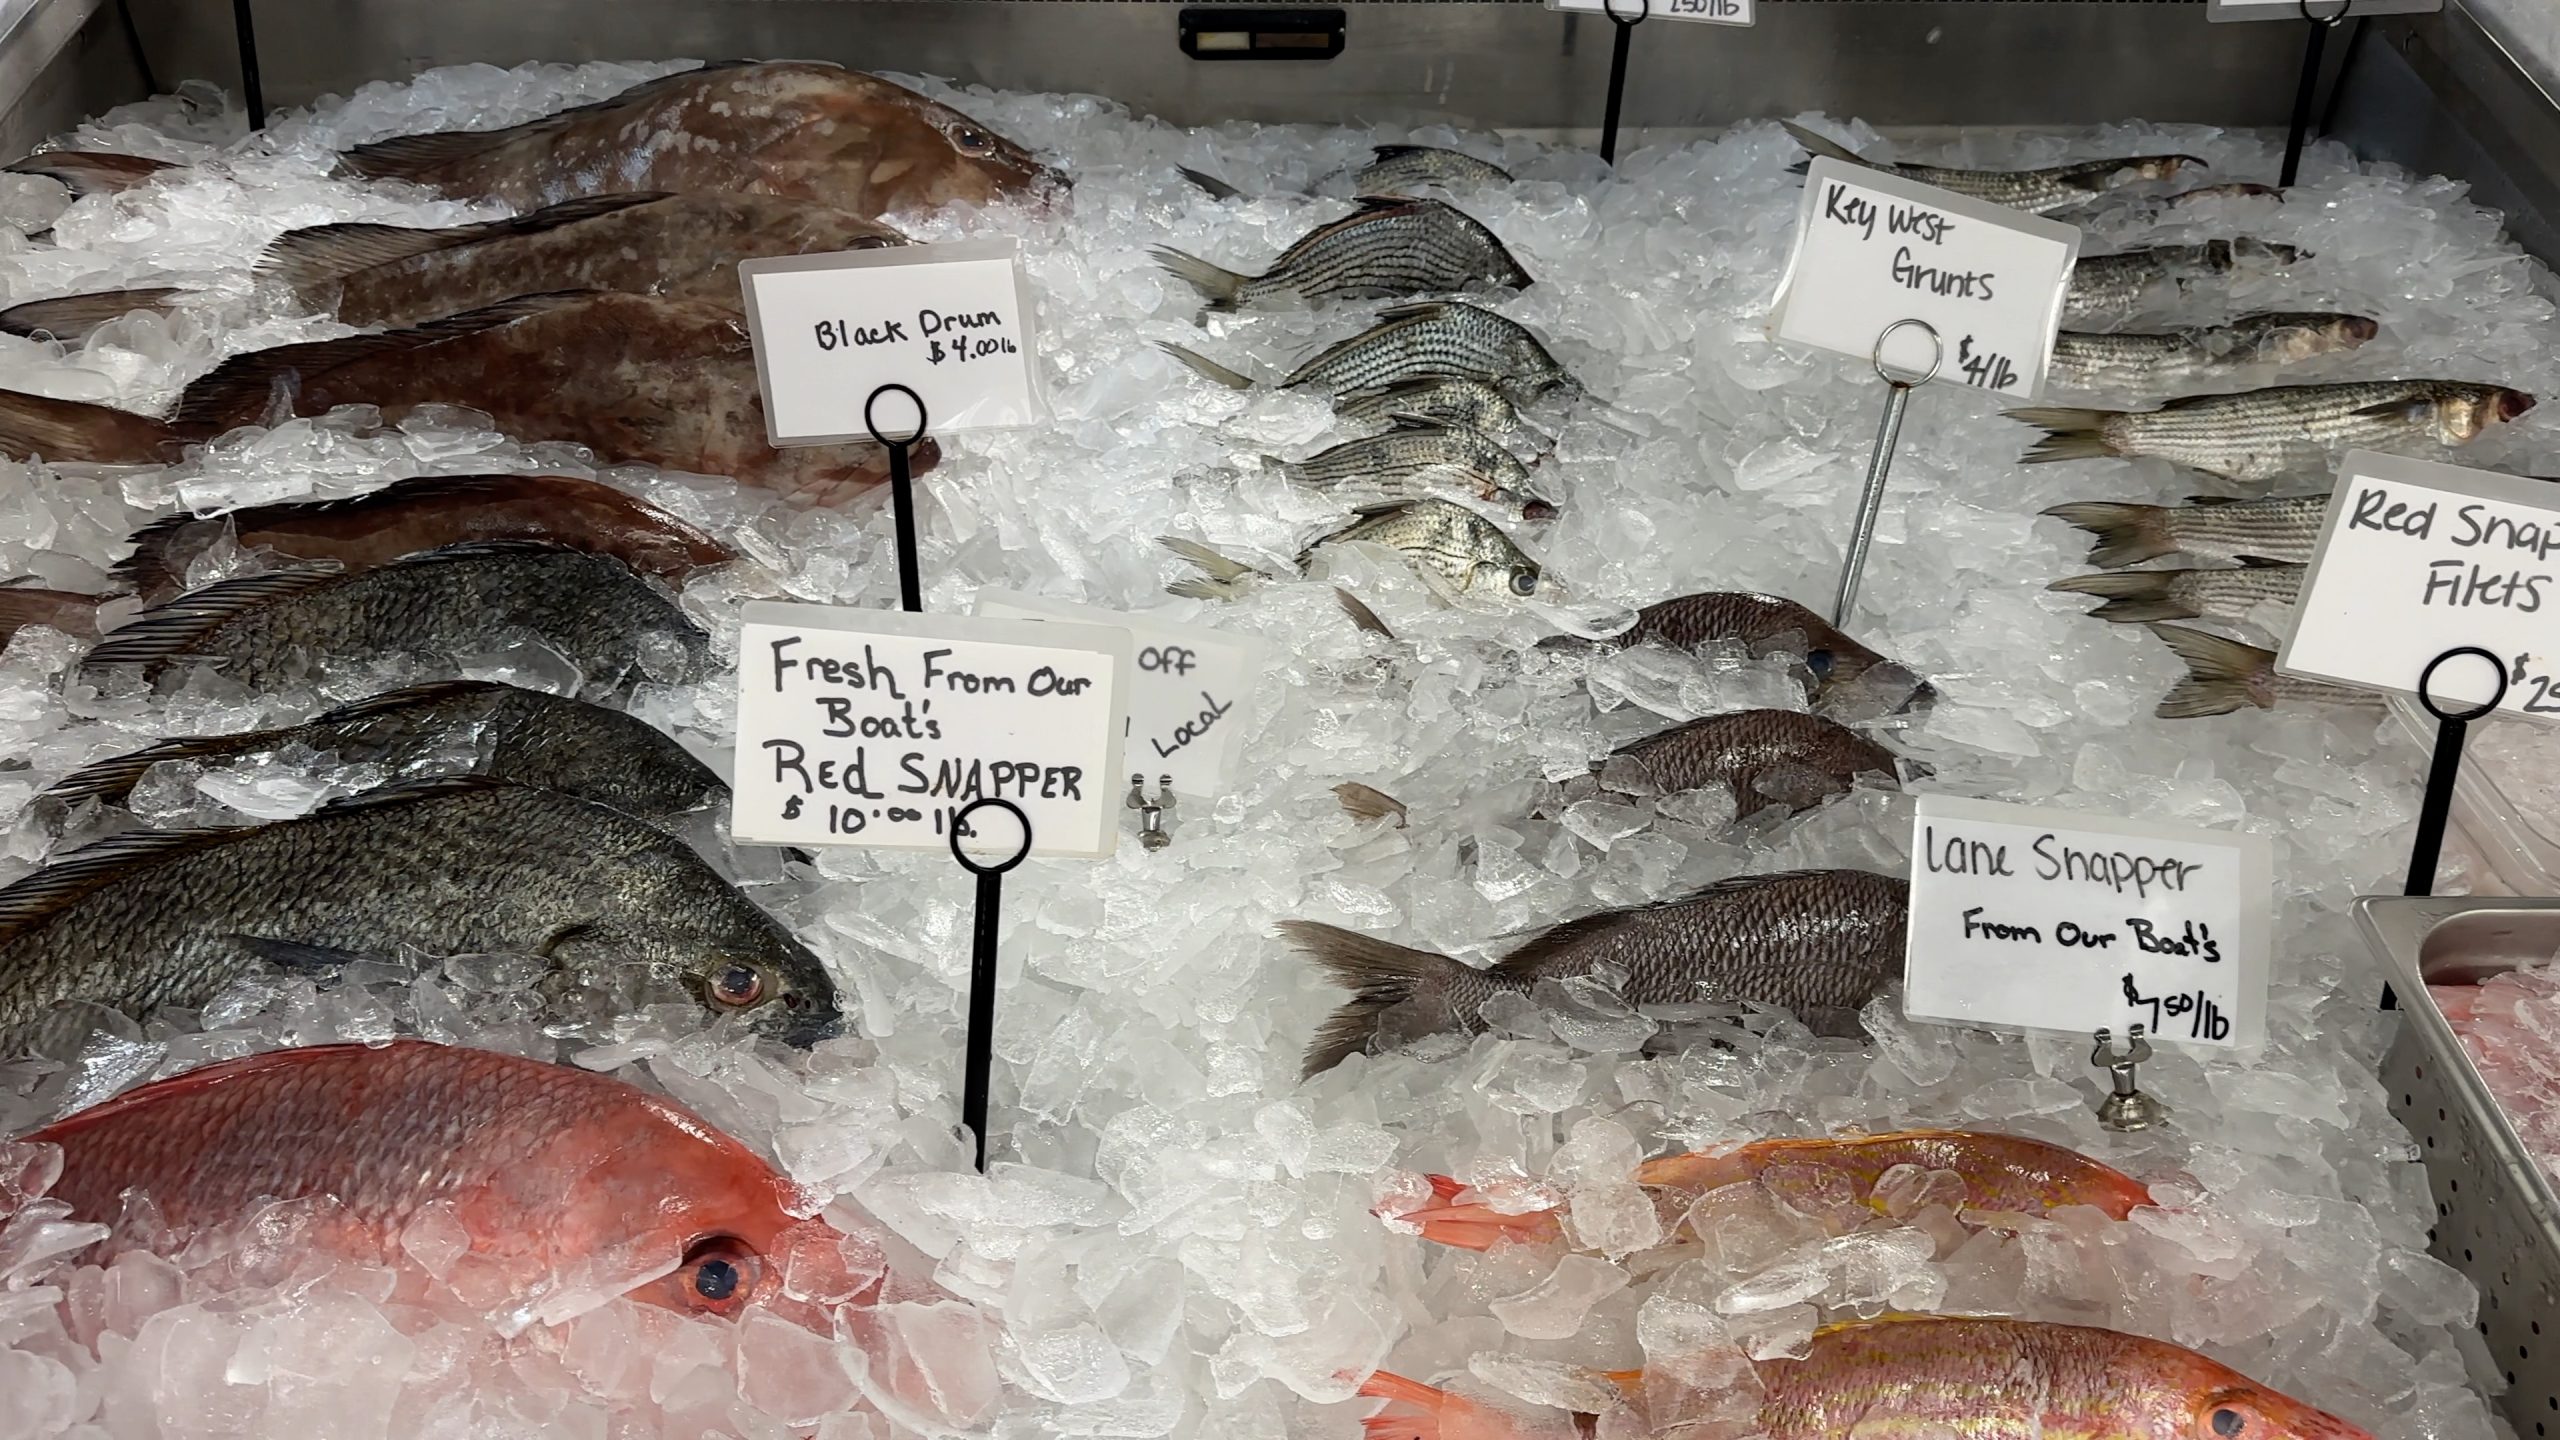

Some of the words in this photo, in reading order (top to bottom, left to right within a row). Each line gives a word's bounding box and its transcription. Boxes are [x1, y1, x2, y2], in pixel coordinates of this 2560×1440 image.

[1825, 184, 1876, 241] Key
[1891, 246, 1995, 301] Grunts
[815, 320, 908, 351] Black
[919, 309, 1001, 337] Drum
[2350, 488, 2437, 540] Red
[2422, 559, 2553, 613] Filets
[771, 636, 906, 699] Fresh
[923, 648, 1016, 694] From
[1027, 666, 1092, 696] Our
[816, 698, 942, 740] Boat's
[898, 753, 1083, 802] SNAPPER
[2032, 834, 2203, 898] Snapper
[1962, 907, 2041, 944] From
[2056, 922, 2117, 948] Our
[2126, 917, 2221, 963] Boat's
